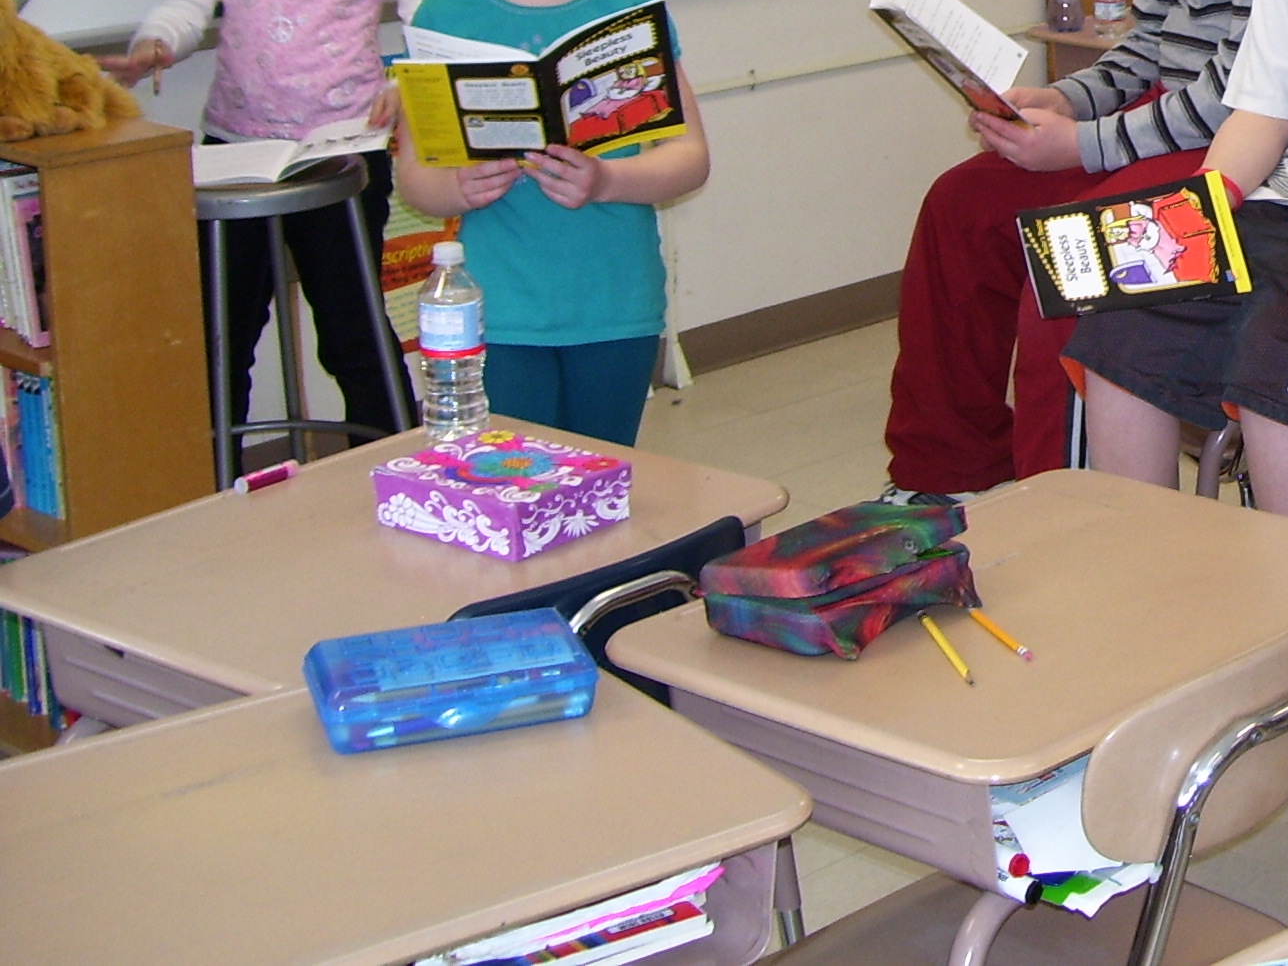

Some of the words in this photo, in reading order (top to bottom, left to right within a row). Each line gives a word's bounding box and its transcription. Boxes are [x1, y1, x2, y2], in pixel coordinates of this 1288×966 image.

[574, 32, 634, 62] Sleepless
[585, 43, 628, 67] Beauty
[1058, 234, 1078, 282] Sleepless
[1074, 237, 1093, 275] Beauty
